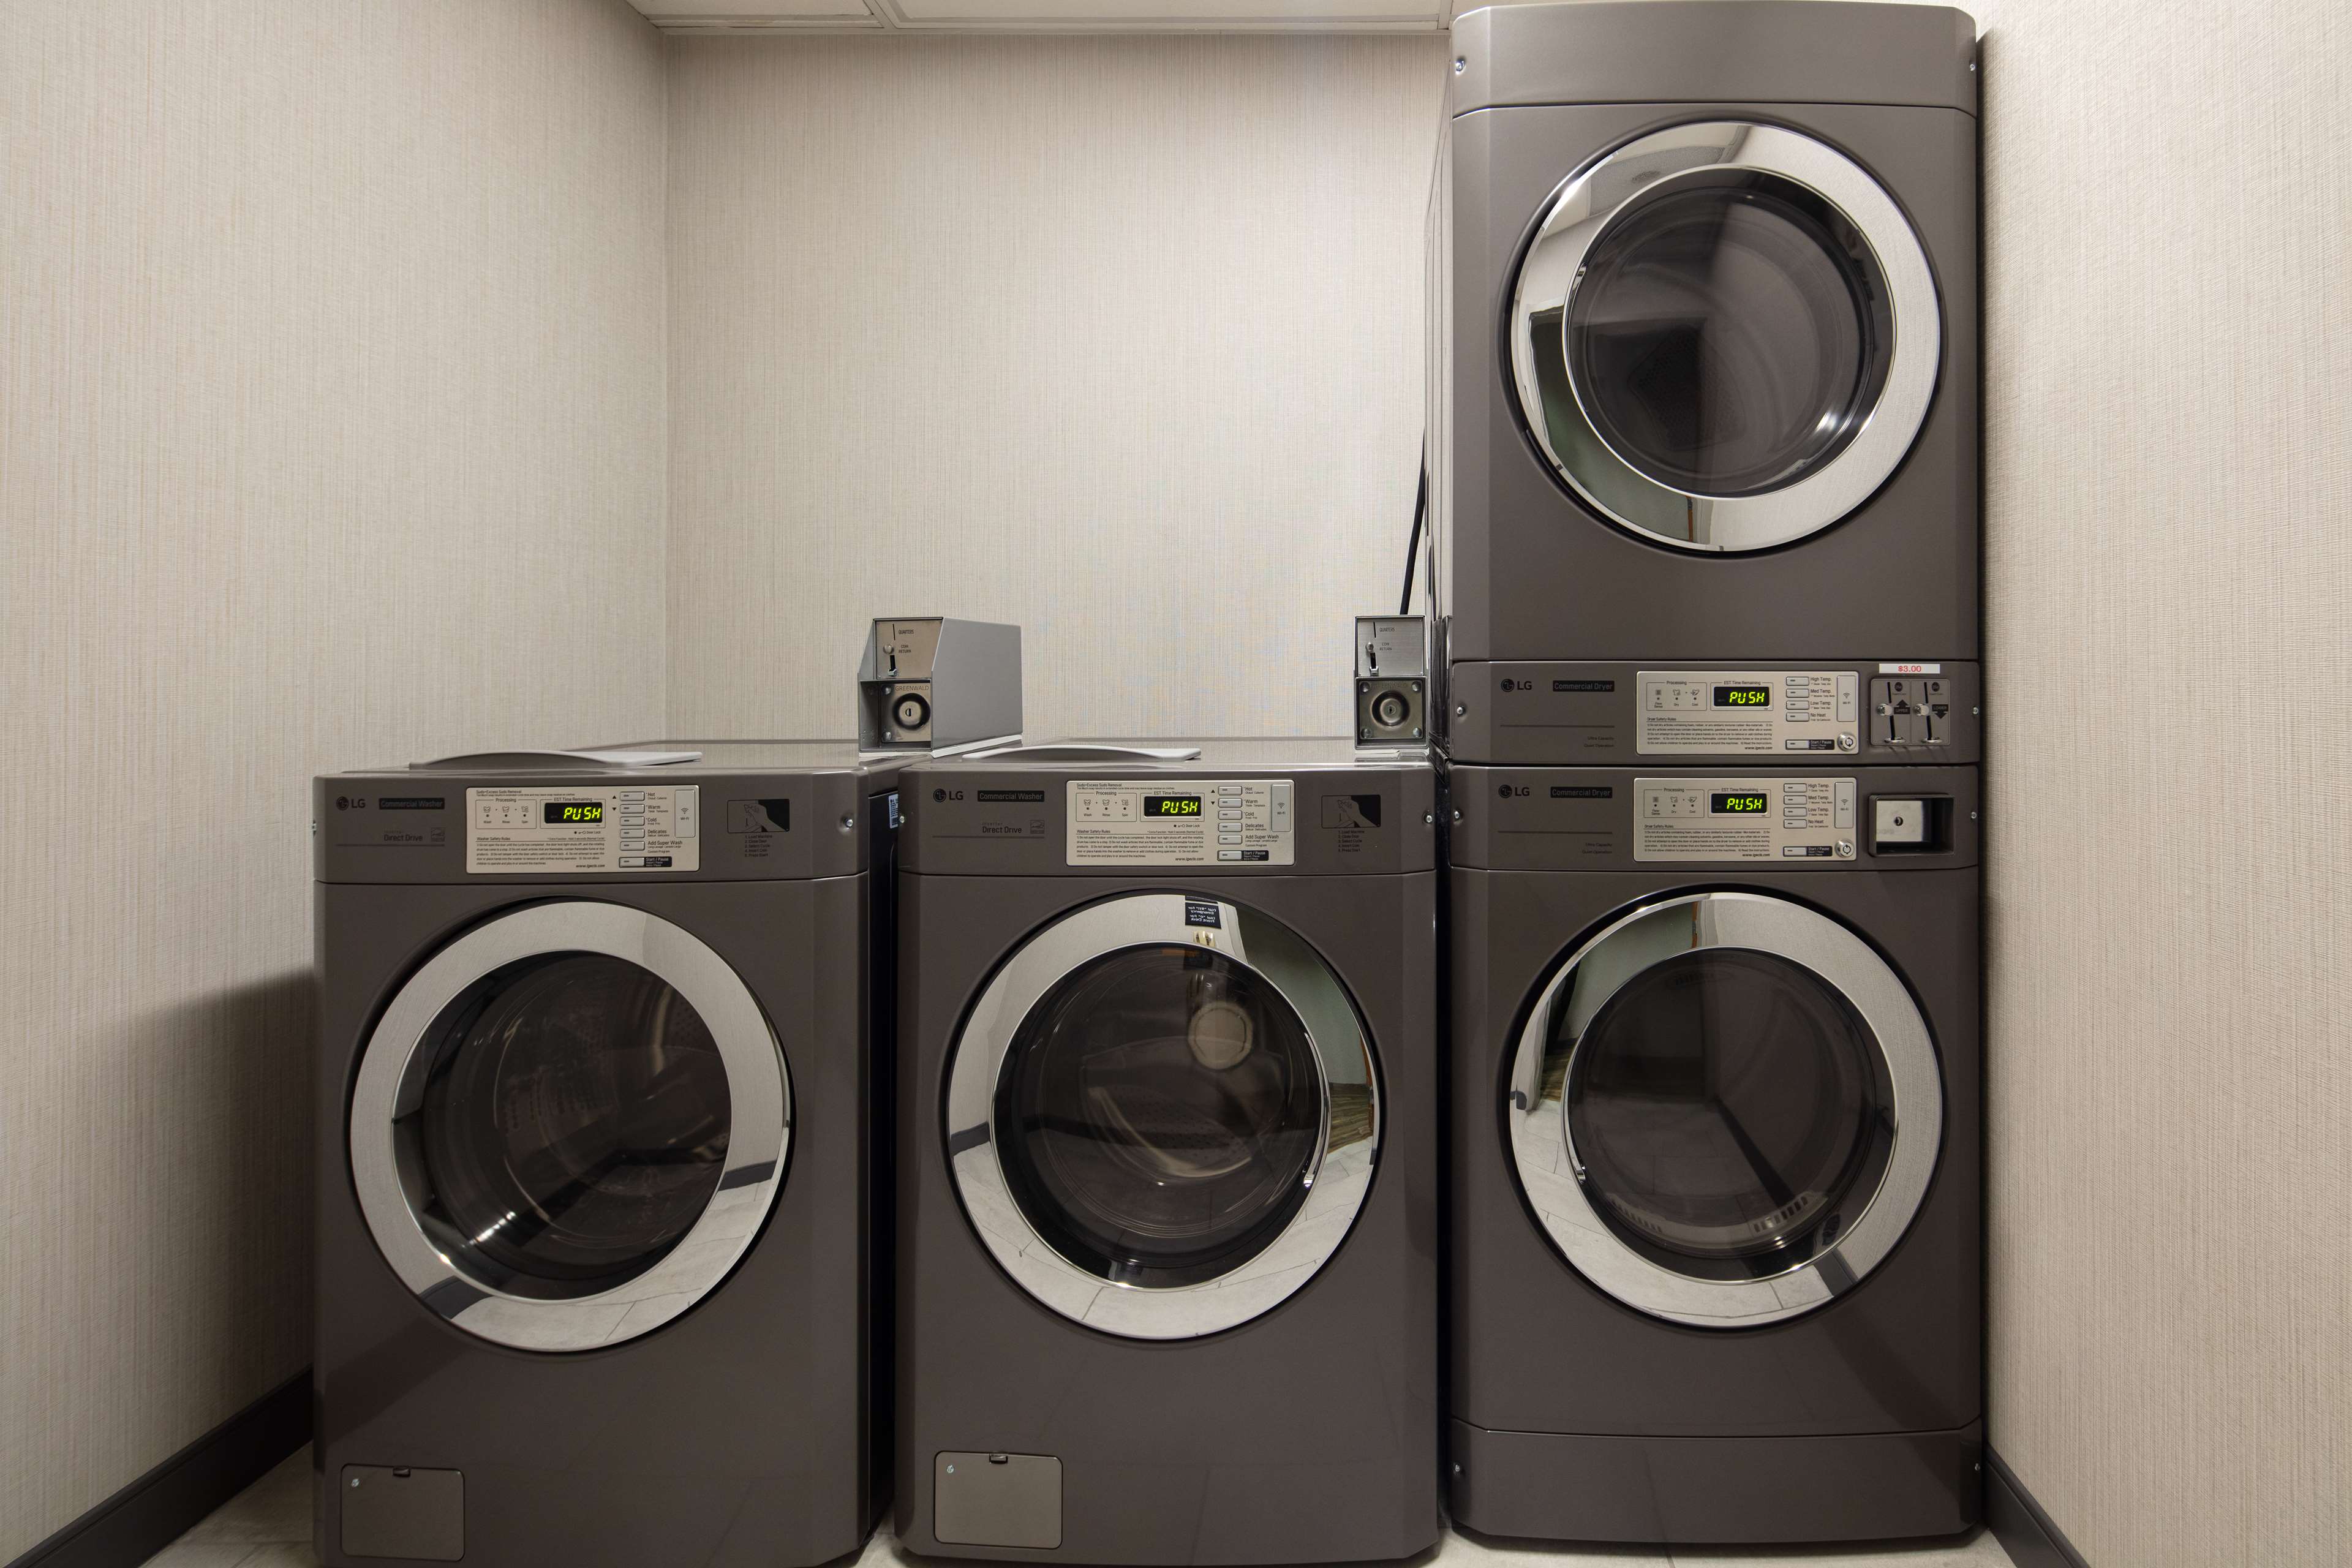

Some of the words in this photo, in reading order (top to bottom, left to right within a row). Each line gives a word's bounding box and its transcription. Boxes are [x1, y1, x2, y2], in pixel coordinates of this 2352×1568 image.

[1517, 681, 1532, 691] LG
[1730, 692, 1765, 704] PUSH
[949, 791, 964, 800] LG
[1515, 787, 1530, 796] LG
[352, 799, 366, 809] LG
[1162, 801, 1198, 813] PUSH
[1726, 798, 1762, 810] PUSH
[564, 807, 601, 820] PUSH
